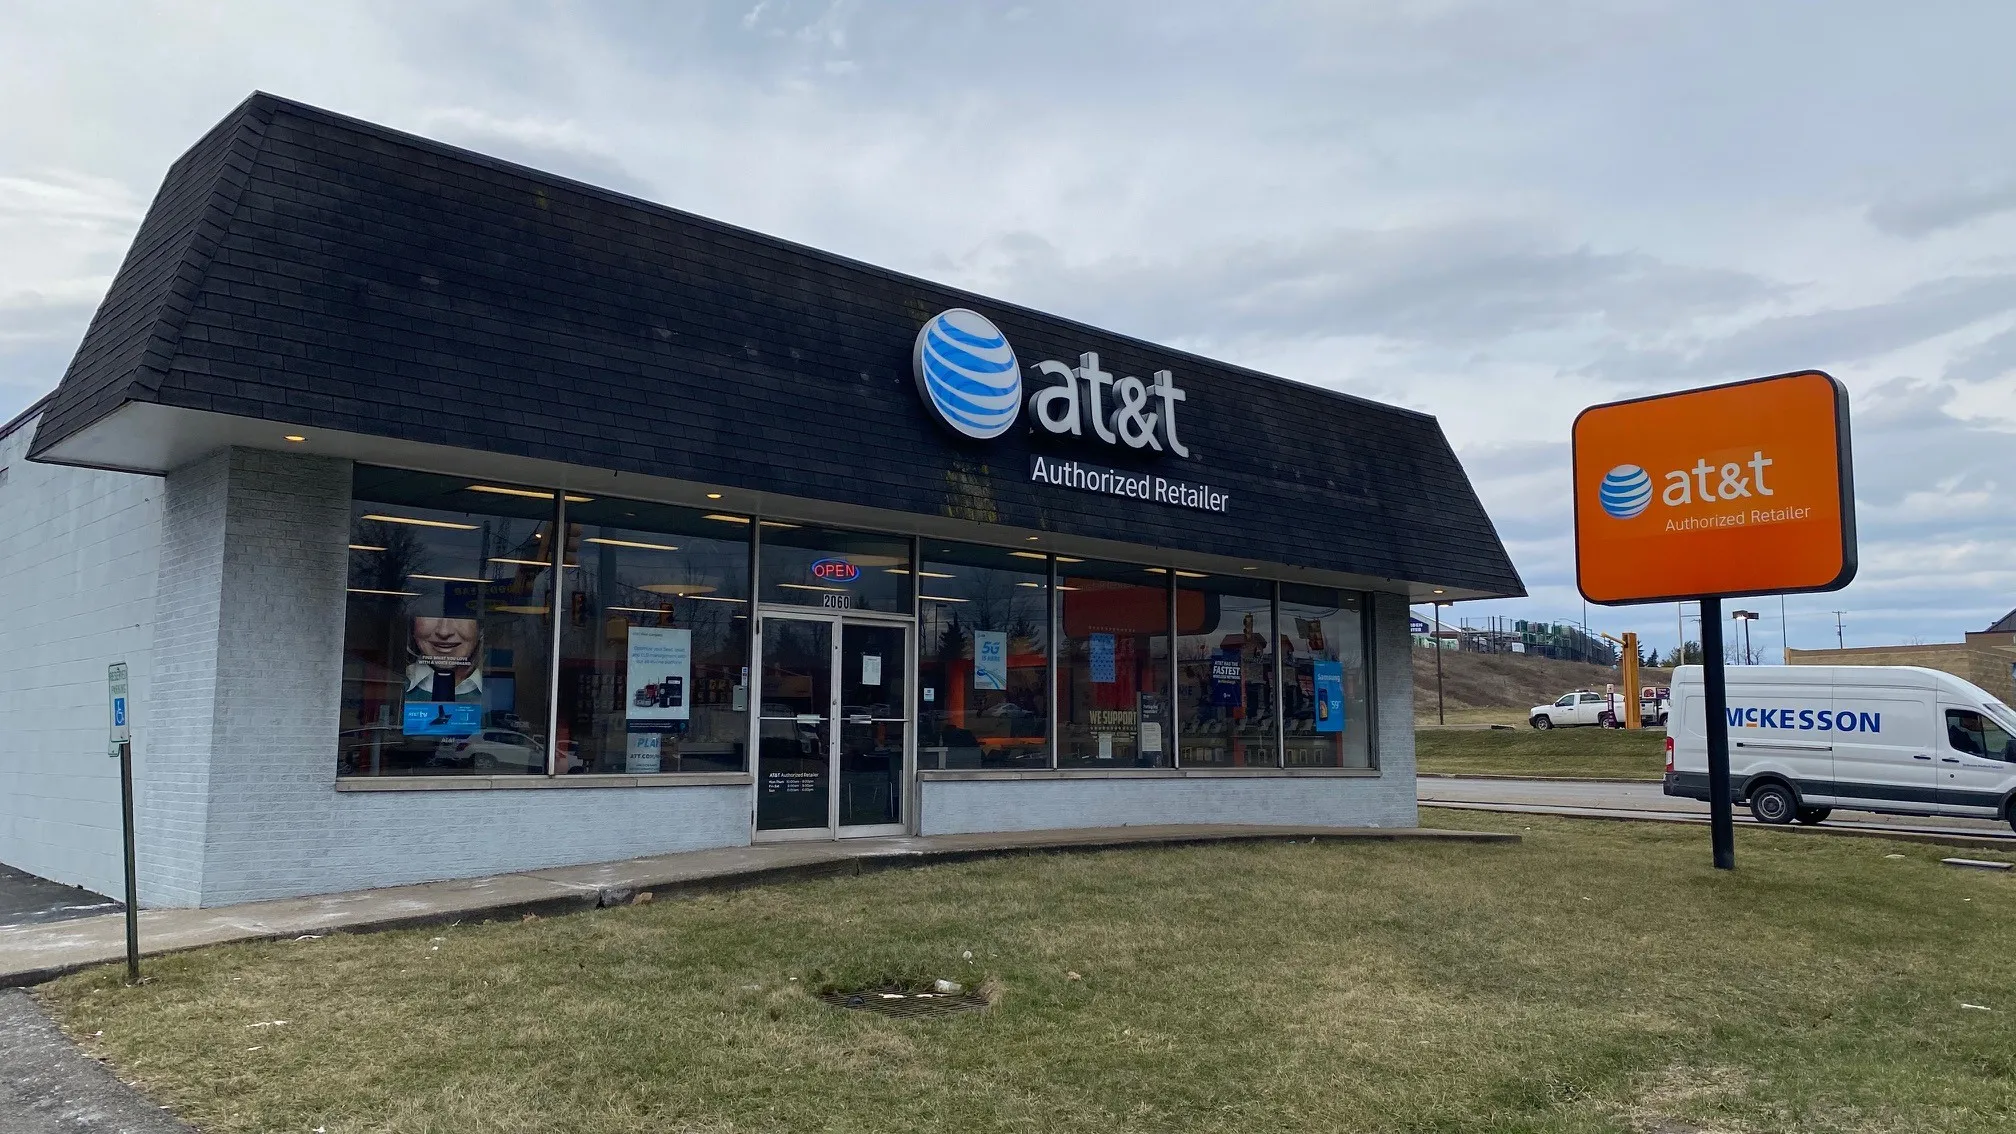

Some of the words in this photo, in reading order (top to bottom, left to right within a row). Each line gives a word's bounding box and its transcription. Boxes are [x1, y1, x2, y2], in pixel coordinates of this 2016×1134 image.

[1029, 351, 1189, 458] at&t
[1031, 456, 1150, 500] Authorized
[1155, 477, 1229, 513] Retailer
[1662, 451, 1774, 507] at&t
[1665, 511, 1745, 532] Authorized
[1750, 506, 1811, 524] Retailer
[814, 564, 855, 577] OPEN
[824, 594, 850, 609] 2060
[981, 641, 1000, 655] 5G
[1212, 665, 1241, 676] FASTEST
[1317, 673, 1341, 683] Samsung
[1089, 711, 1102, 725] WE
[1102, 711, 1137, 725] SUPPORT
